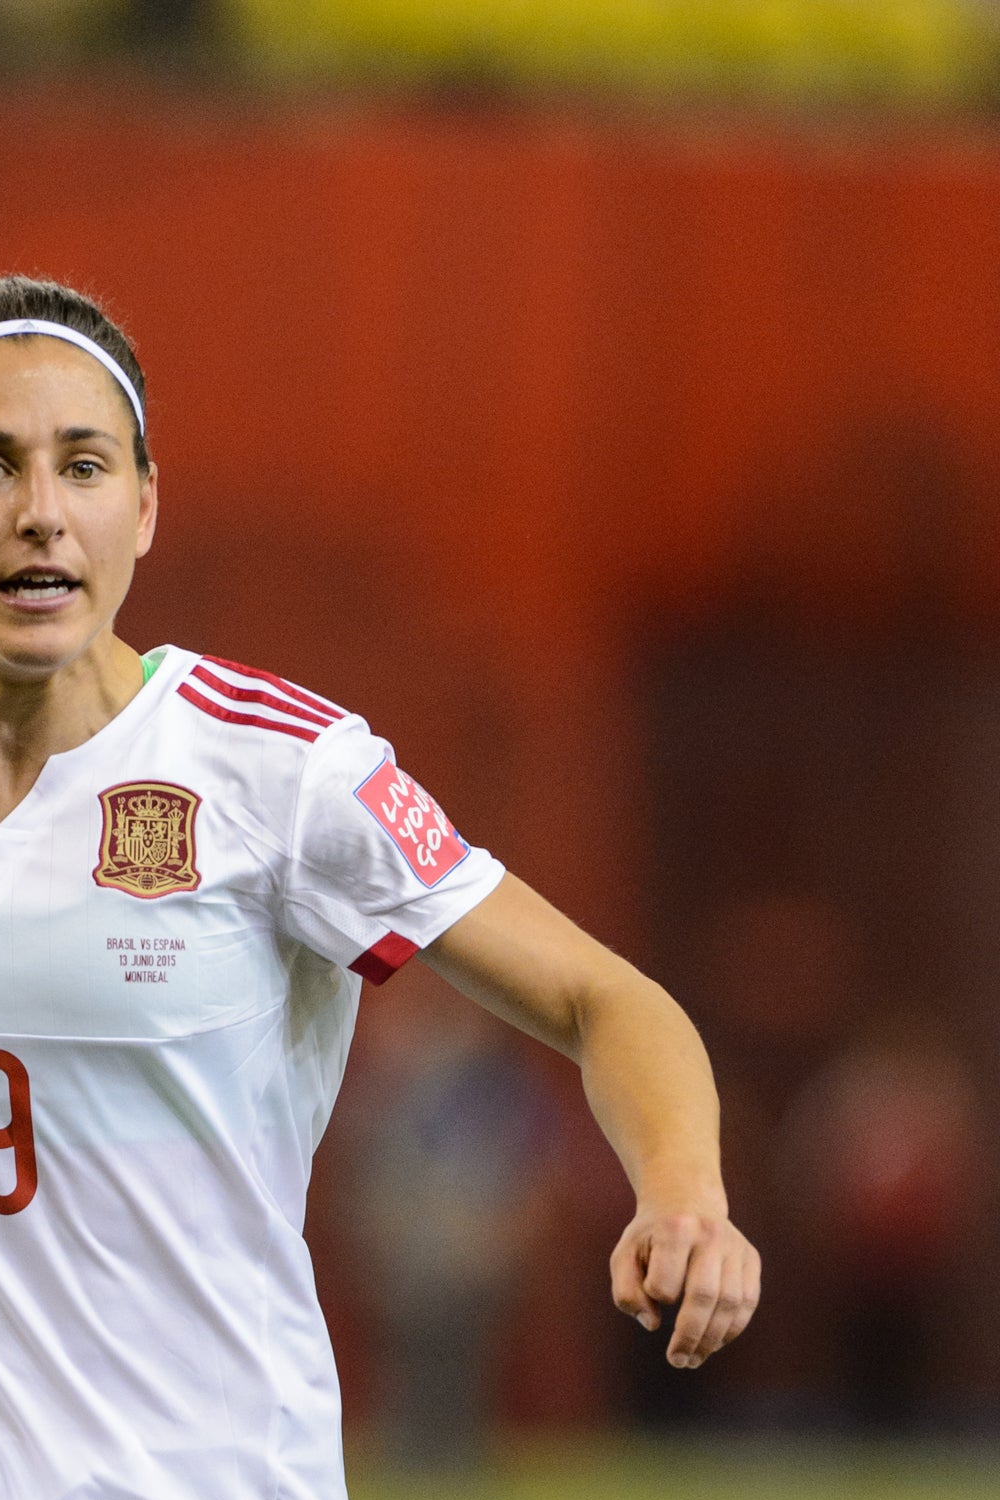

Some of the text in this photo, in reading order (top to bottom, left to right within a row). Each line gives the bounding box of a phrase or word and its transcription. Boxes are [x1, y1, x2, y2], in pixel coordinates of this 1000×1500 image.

[106, 937, 137, 951] BRASIL
[140, 938, 152, 951] VS
[119, 954, 177, 968] 13 JUNIO 2015
[124, 970, 169, 984] MONTREAL
